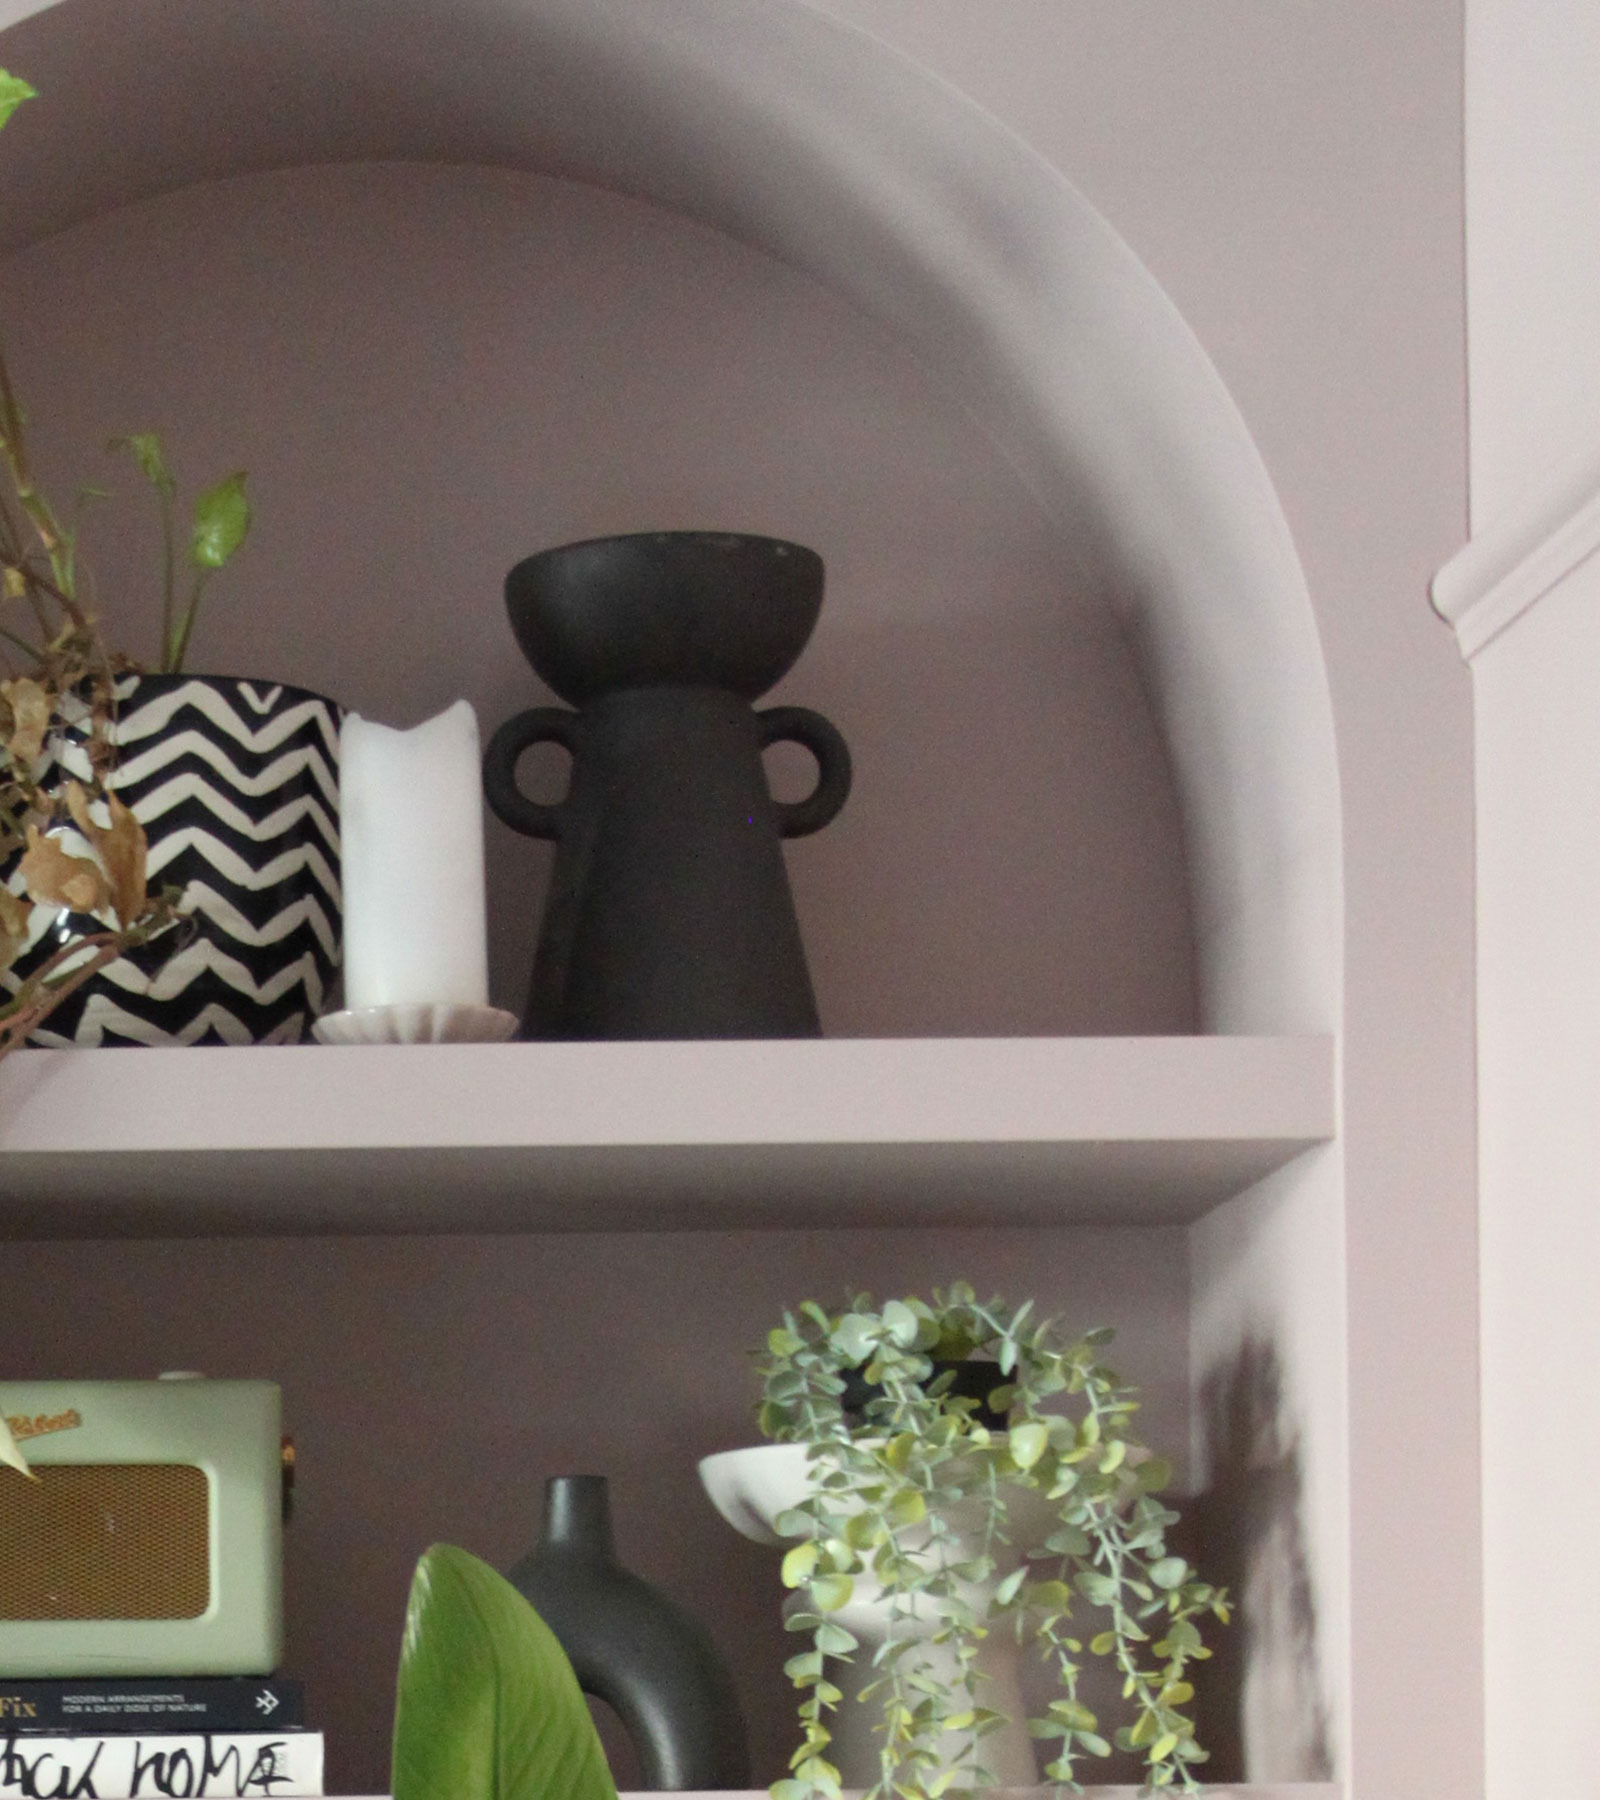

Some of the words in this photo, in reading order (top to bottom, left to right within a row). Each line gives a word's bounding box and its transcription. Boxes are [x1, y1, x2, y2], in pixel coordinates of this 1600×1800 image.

[62, 1695, 105, 1704] MODERN
[107, 1694, 185, 1703] ARRANGEMENTS
[62, 1704, 82, 1713] FOR
[85, 1704, 93, 1713] A
[94, 1704, 122, 1713] DAILY
[123, 1704, 150, 1713] DOSE
[152, 1704, 166, 1713] OF
[167, 1703, 207, 1713] NATURE
